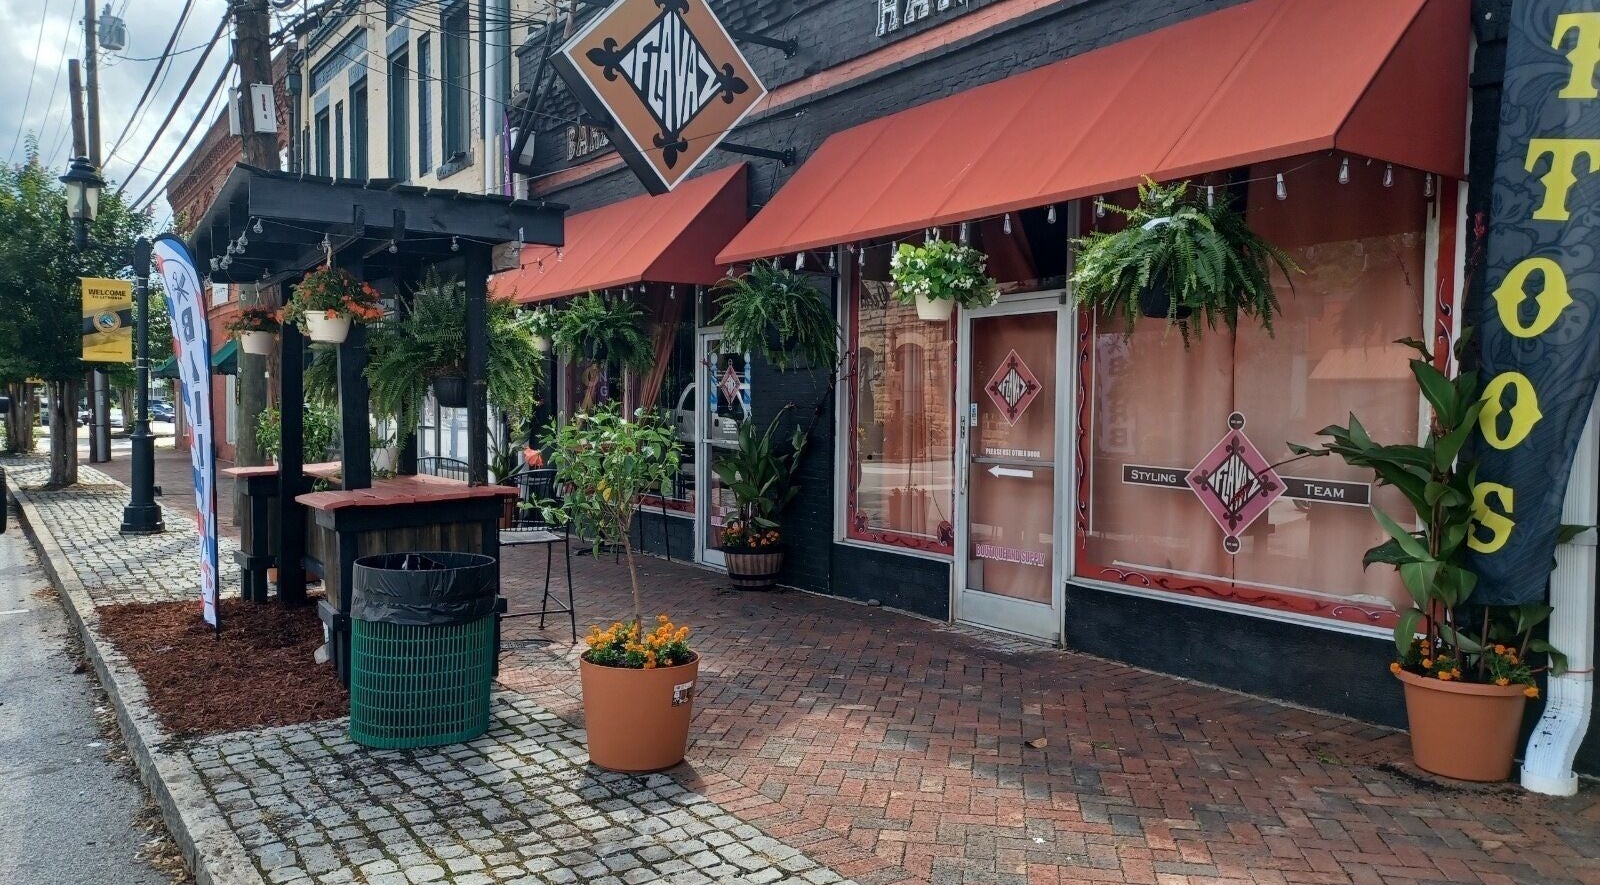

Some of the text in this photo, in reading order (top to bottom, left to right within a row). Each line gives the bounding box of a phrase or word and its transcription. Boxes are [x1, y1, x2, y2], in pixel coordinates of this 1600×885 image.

[633, 9, 722, 132] FLAVAZ
[88, 288, 126, 297] WELCOME
[985, 447, 1002, 456] PLEASE
[1011, 449, 1027, 457] OTHER
[1027, 450, 1041, 458] DOOR
[1131, 469, 1177, 484] STYLING
[1304, 483, 1345, 499] TEAM
[976, 543, 1006, 561] BOUTIQUE
[1020, 550, 1046, 567] SUPPLY
